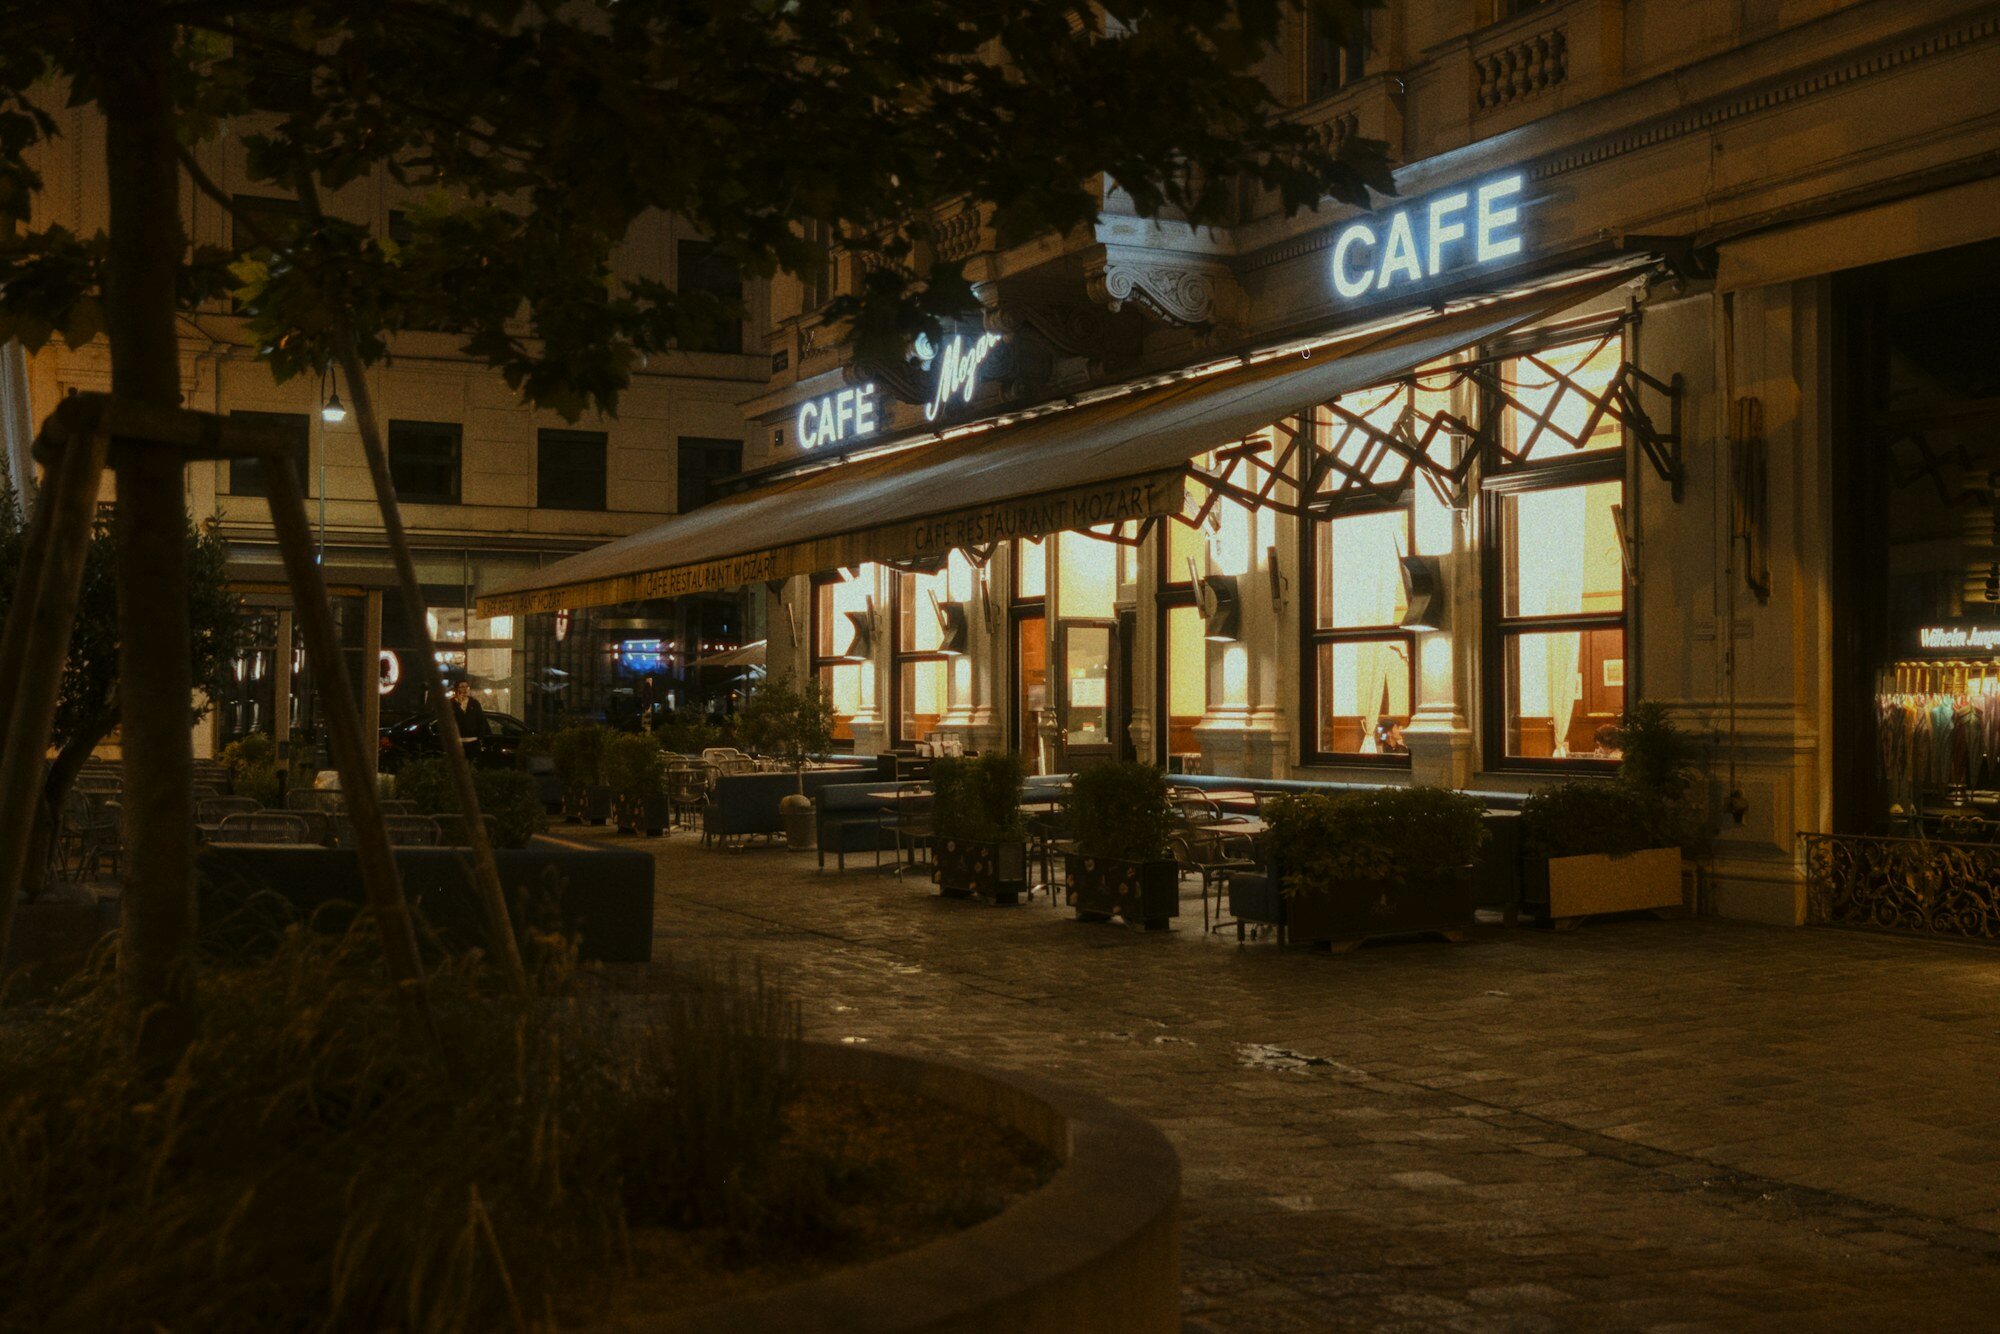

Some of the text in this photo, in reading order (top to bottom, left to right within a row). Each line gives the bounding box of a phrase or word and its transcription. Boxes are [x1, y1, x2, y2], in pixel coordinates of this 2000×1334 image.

[956, 501, 1066, 544] RESTAURANT
[1072, 483, 1155, 527] MOZART
[671, 564, 731, 592] RESTAURANT
[734, 556, 776, 584] MOZART
